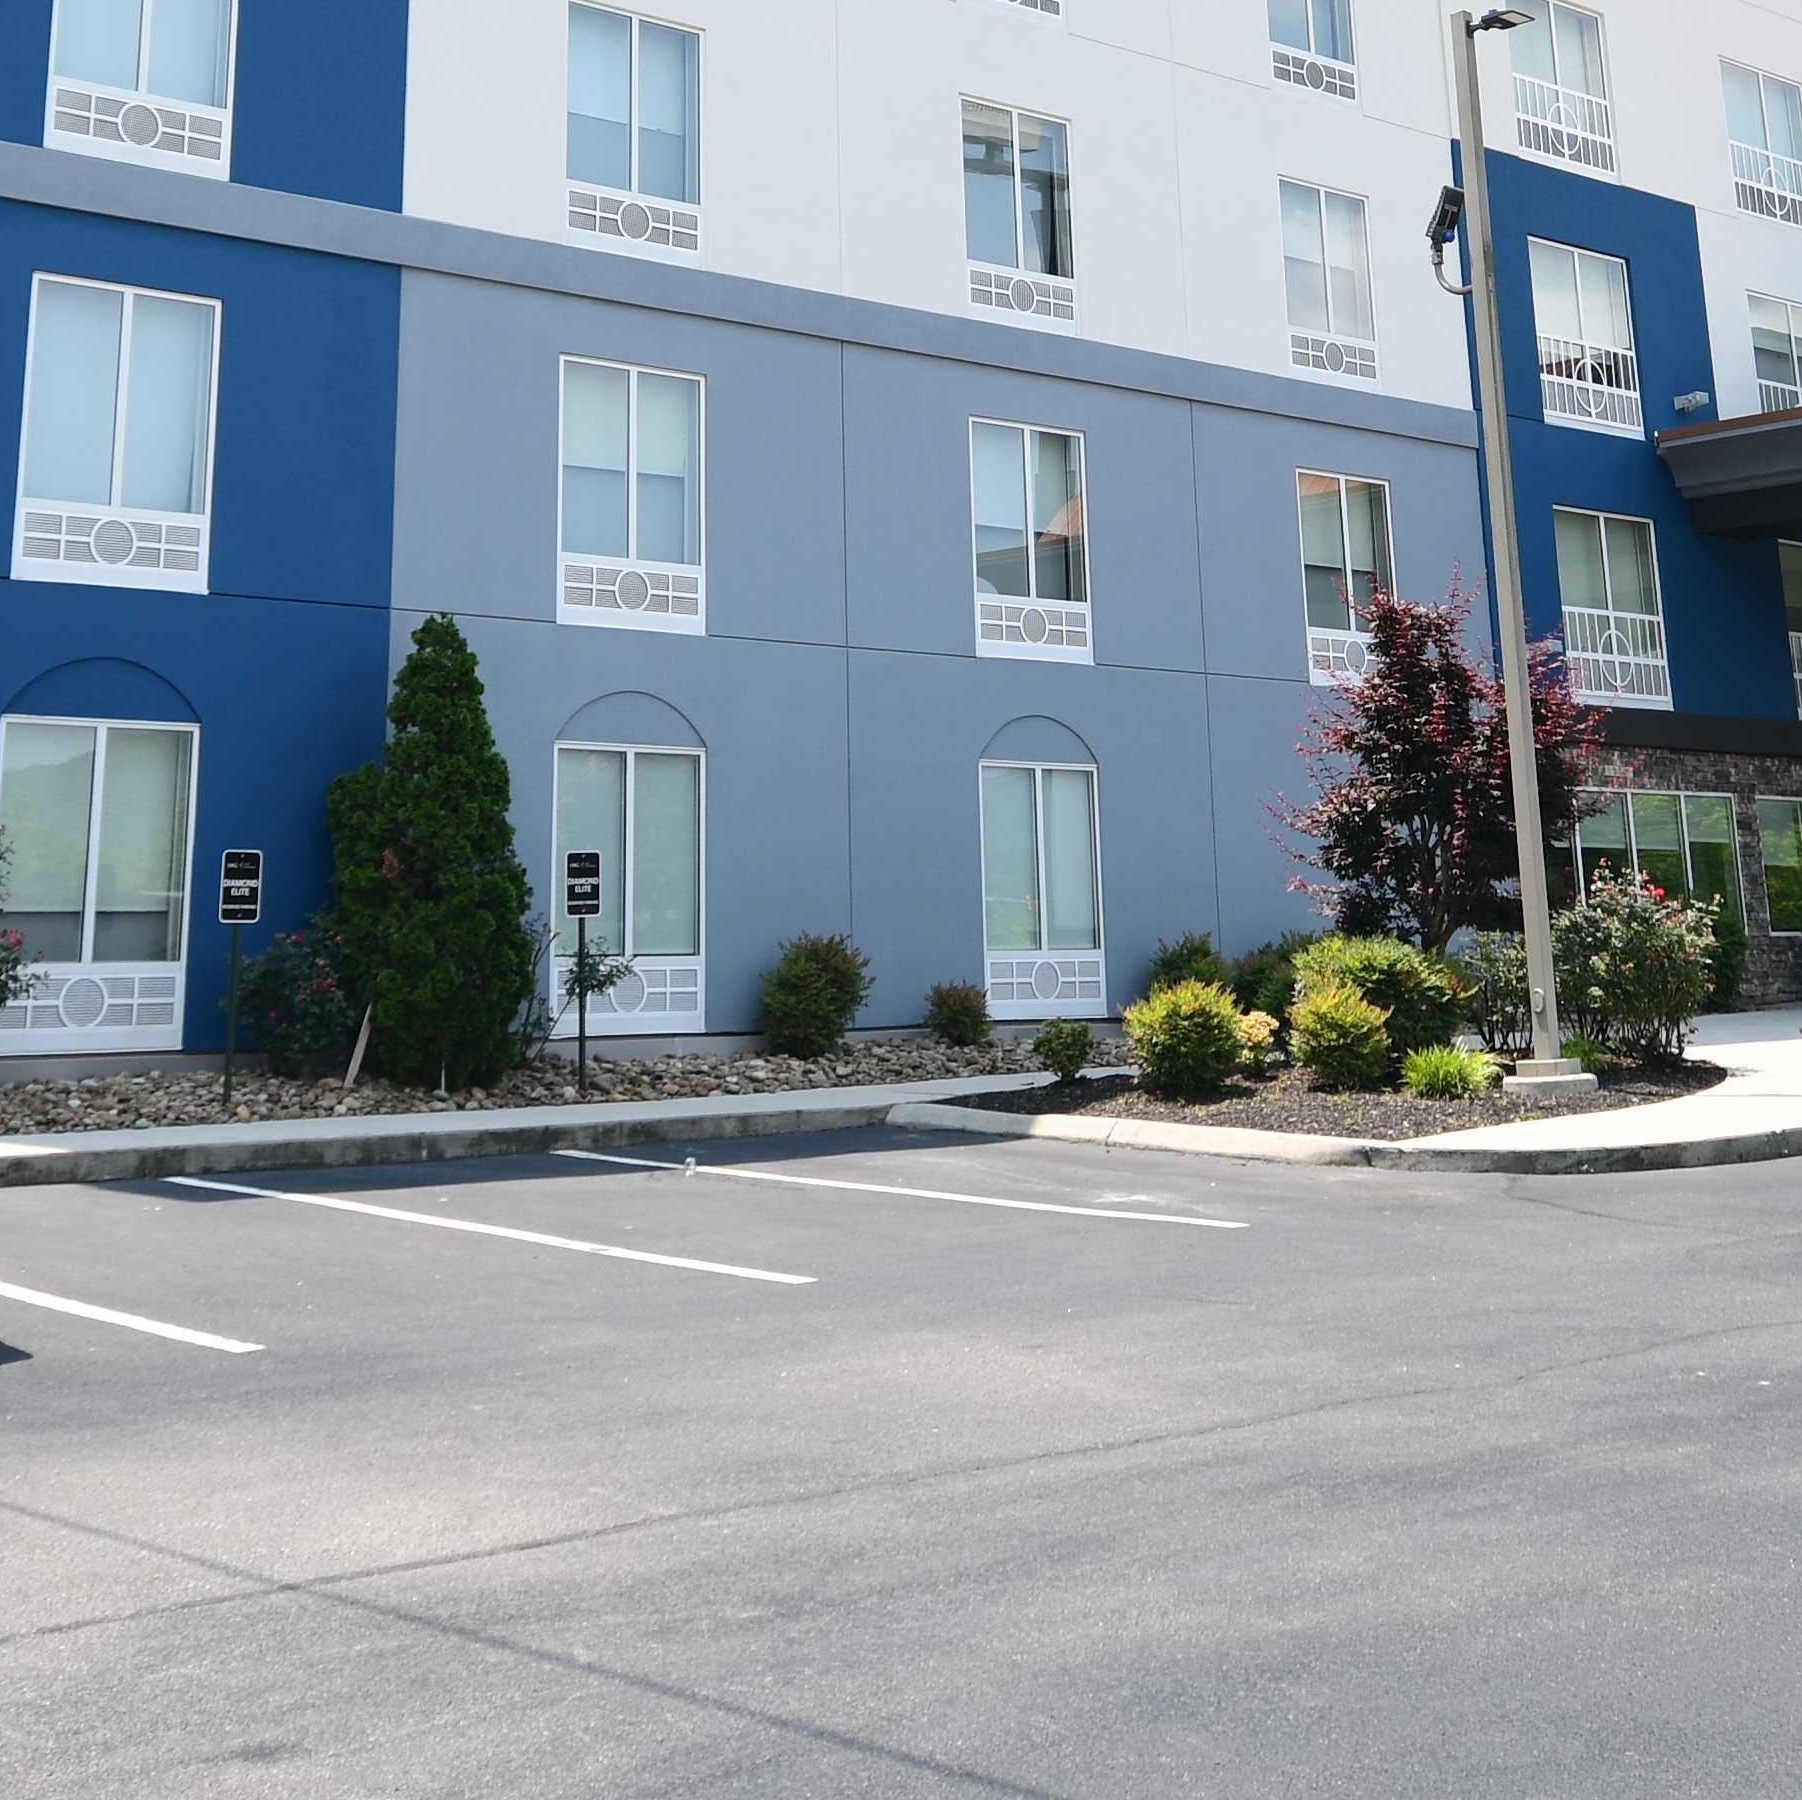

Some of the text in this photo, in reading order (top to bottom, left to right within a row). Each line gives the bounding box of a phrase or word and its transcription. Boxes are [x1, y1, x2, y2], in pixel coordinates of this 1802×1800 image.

[223, 879, 258, 888] DIAMOND
[567, 877, 599, 886] DIAMOND
[230, 888, 250, 897] ELITE
[574, 885, 592, 894] ELITE
